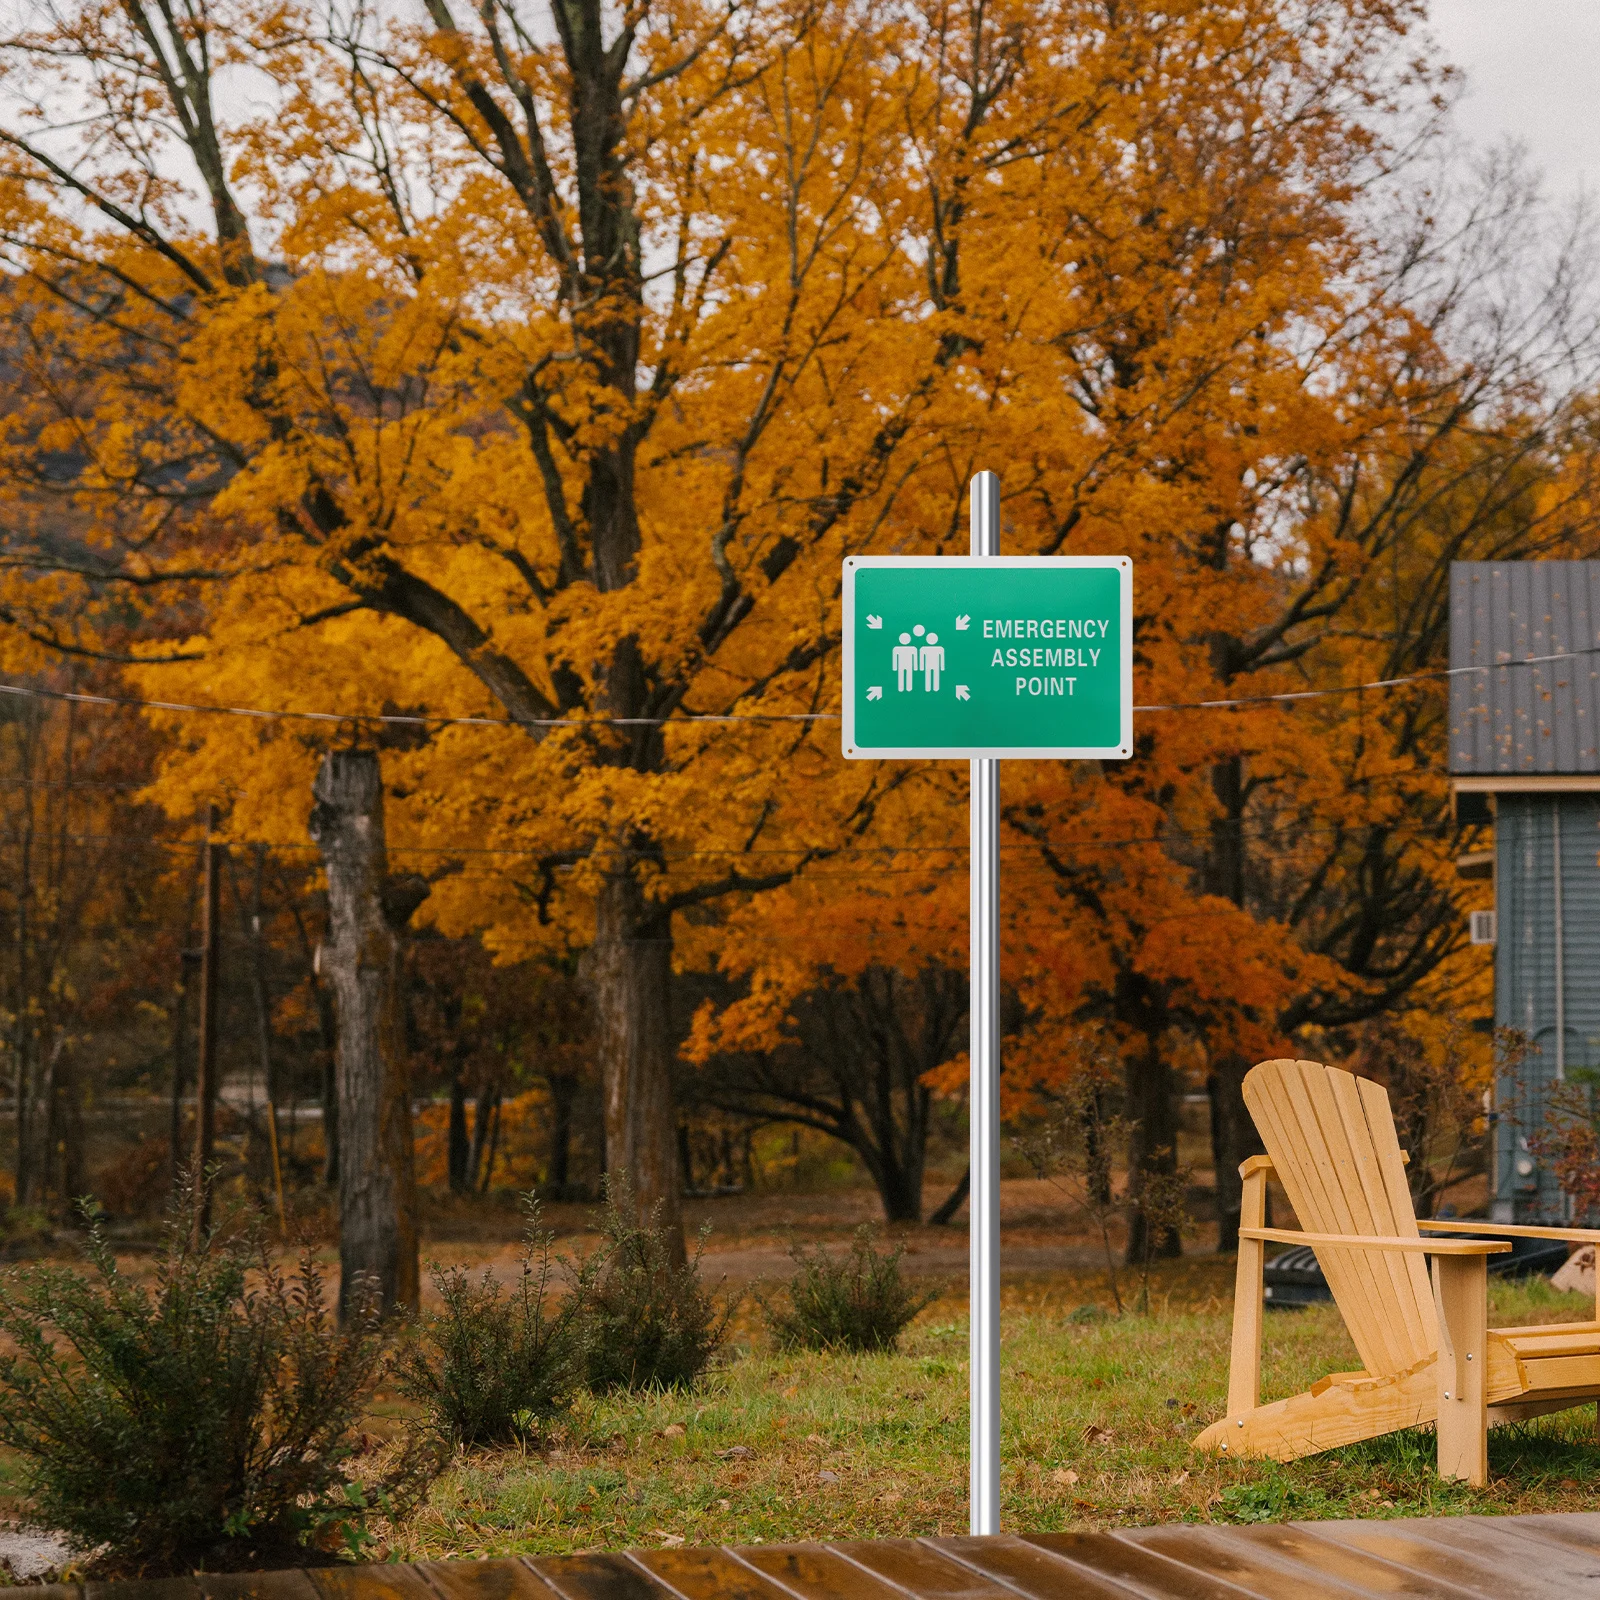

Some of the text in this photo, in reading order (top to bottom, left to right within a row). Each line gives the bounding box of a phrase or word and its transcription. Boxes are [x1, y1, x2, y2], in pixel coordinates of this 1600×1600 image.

[983, 619, 1109, 638] EMERGENCY
[991, 648, 1101, 667] ASSEMBLY
[1016, 677, 1077, 696] POINT
